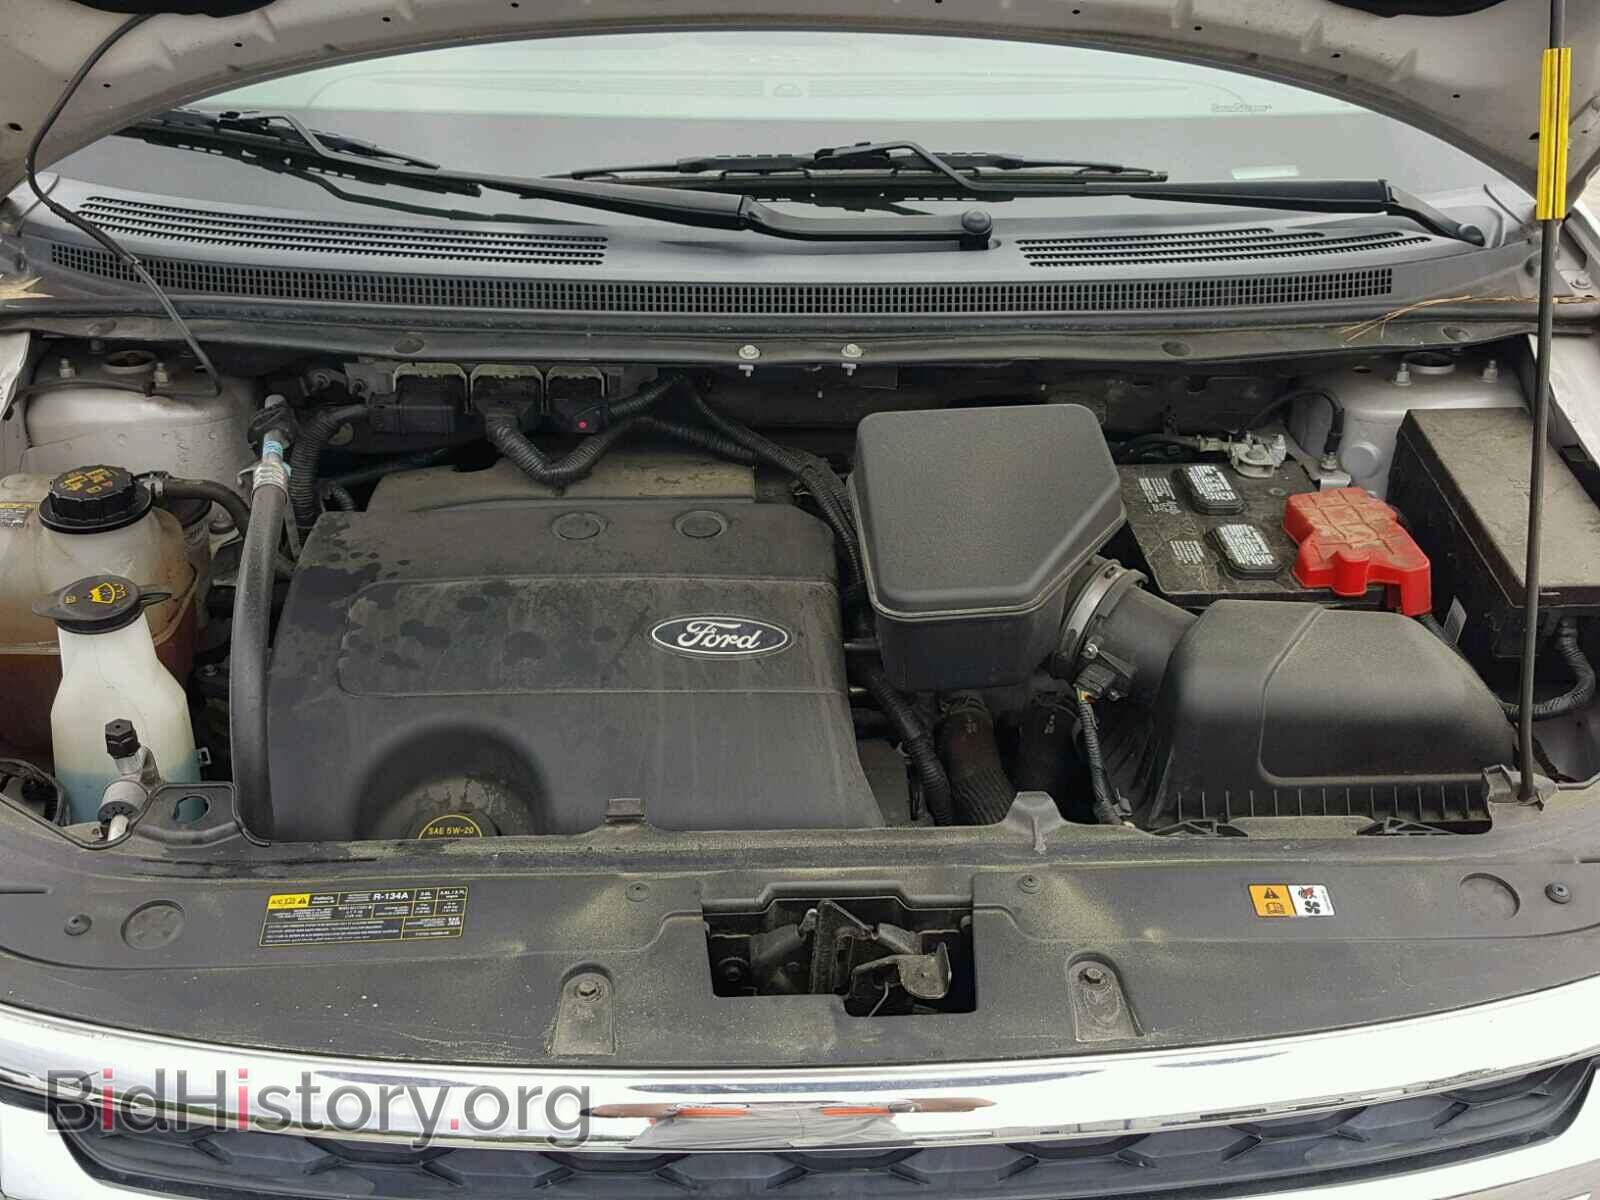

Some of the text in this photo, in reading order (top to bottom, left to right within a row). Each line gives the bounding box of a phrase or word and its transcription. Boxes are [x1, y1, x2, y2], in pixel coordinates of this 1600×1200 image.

[678, 621, 762, 648] Ford
[428, 826, 474, 835] SAE 5W-20
[373, 892, 409, 900] R-134A
